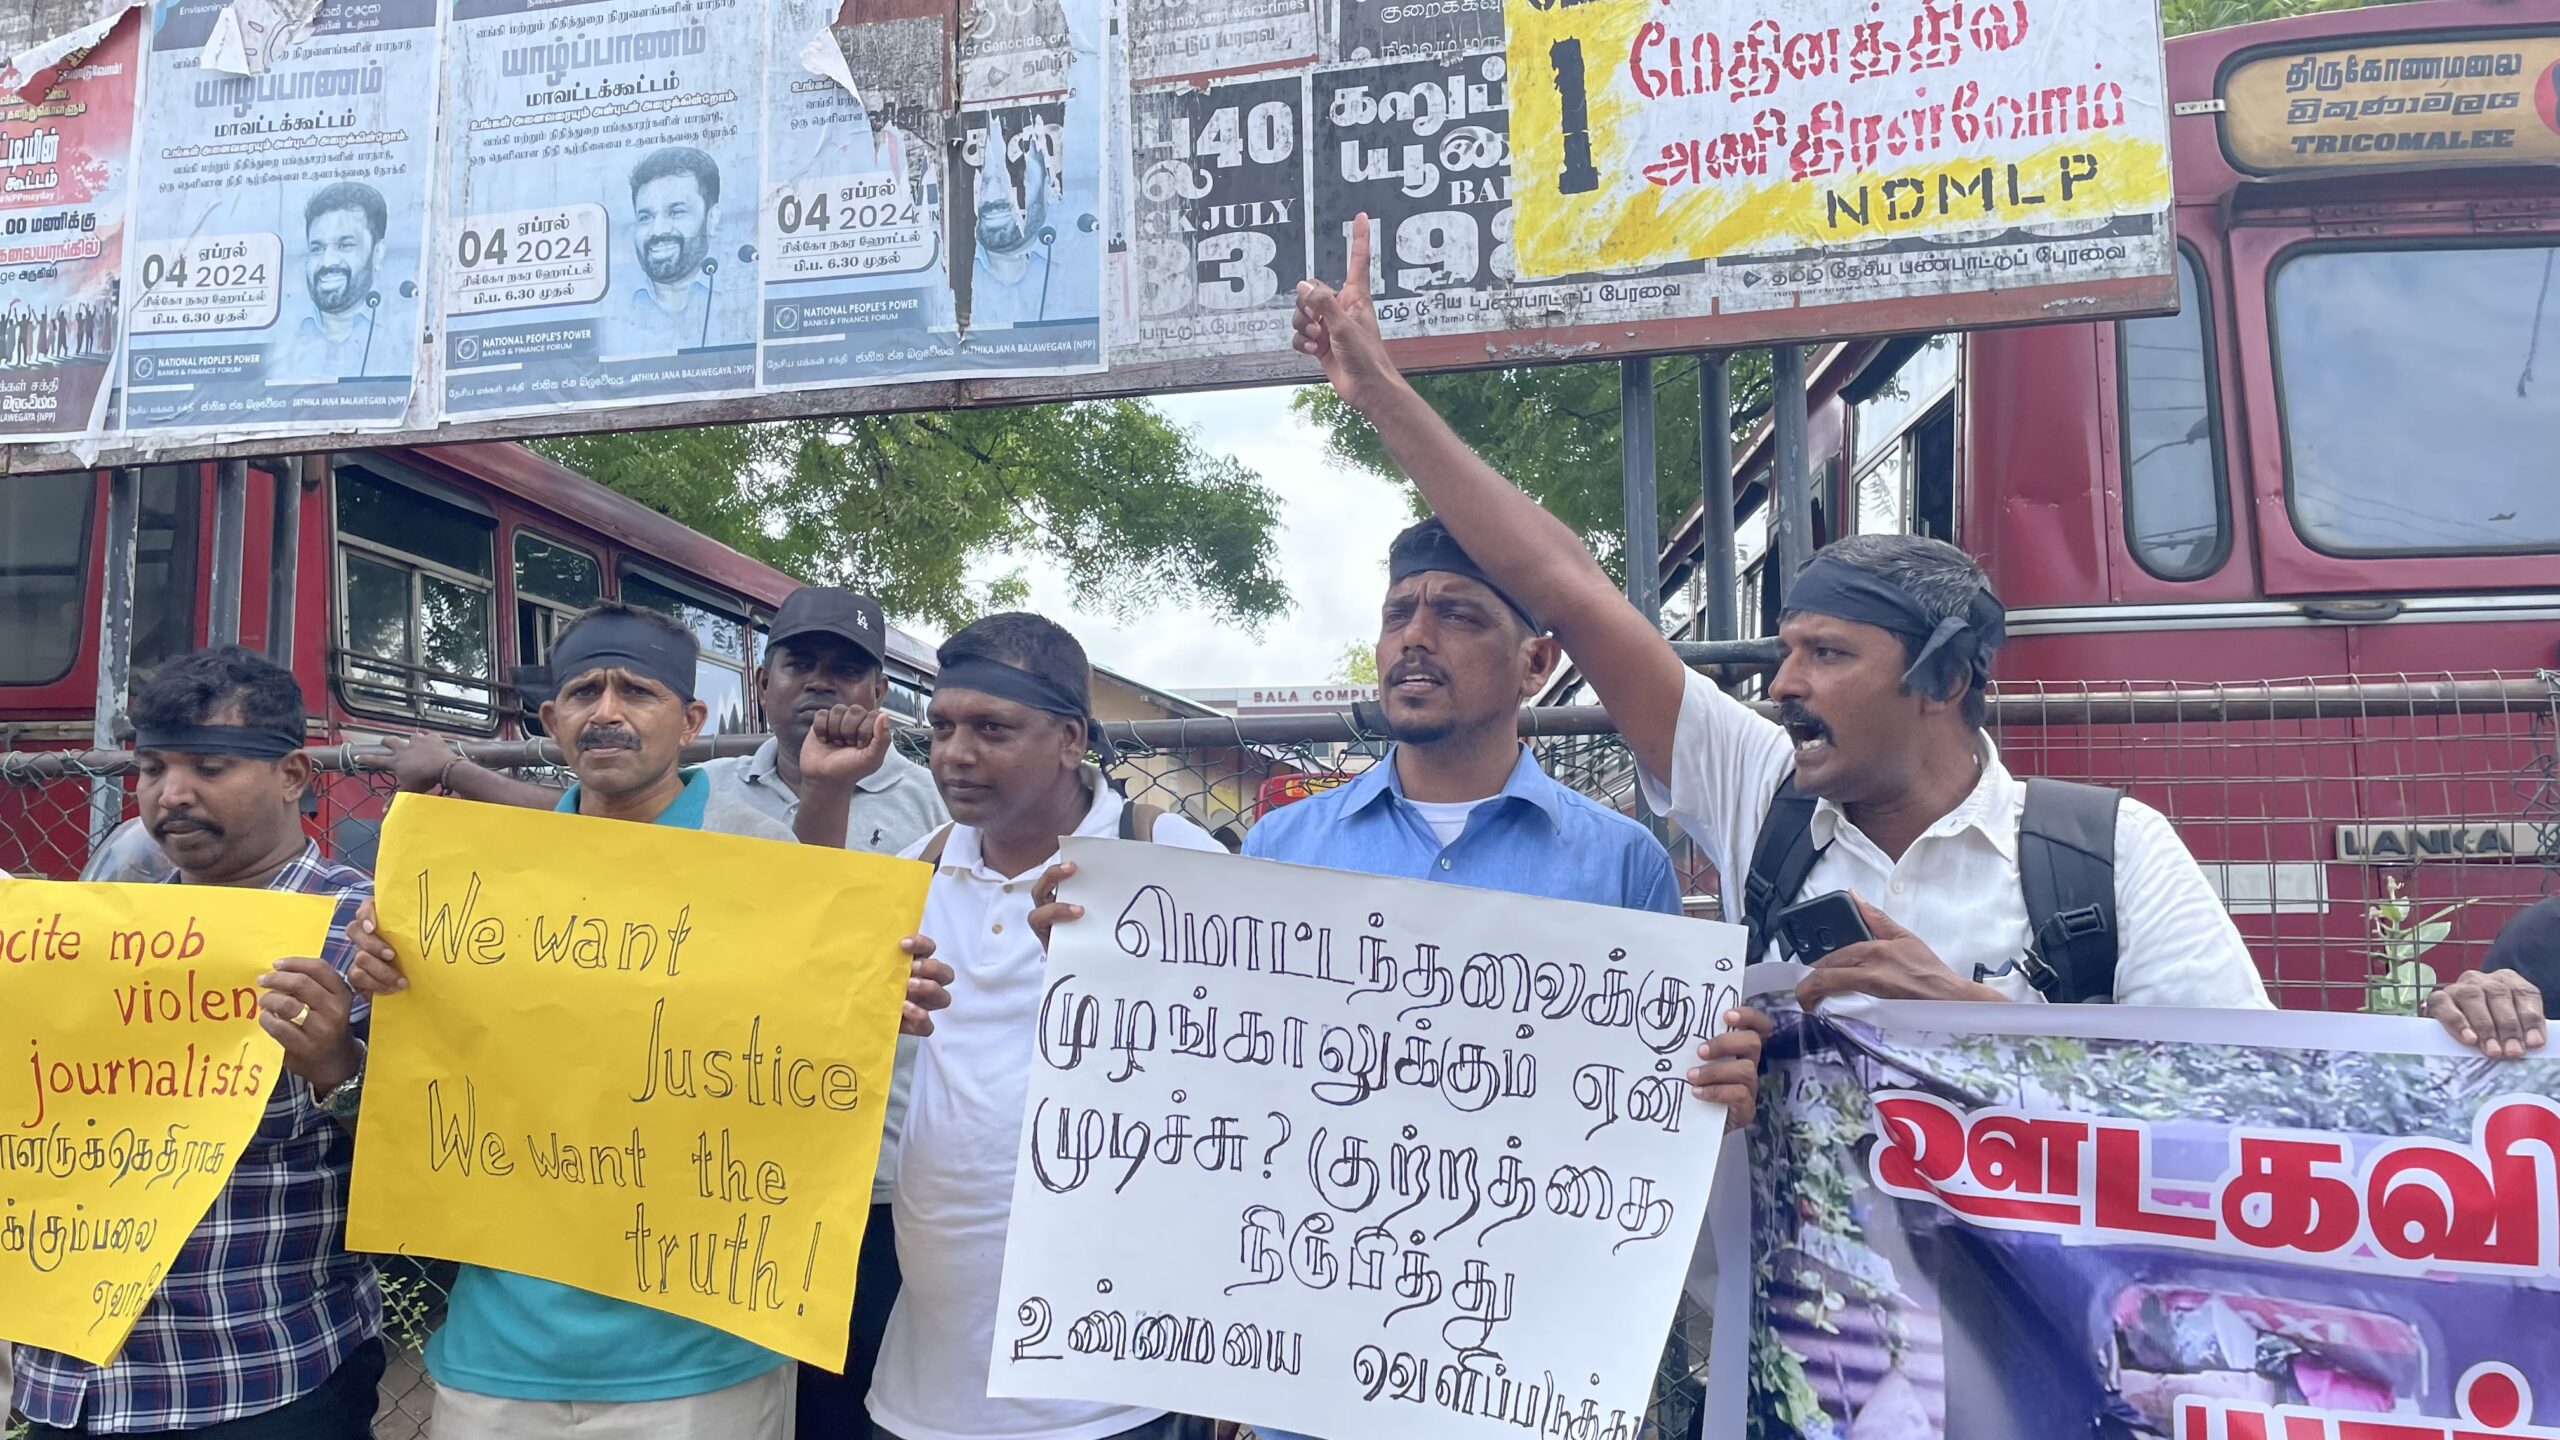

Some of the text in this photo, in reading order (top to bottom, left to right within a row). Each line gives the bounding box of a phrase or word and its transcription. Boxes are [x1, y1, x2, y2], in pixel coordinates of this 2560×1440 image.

[502, 17, 706, 86] யாழ்ப்பாணம்
[982, 34, 1046, 54] Genocide,
[2286, 53, 2522, 93] திருகோணமலை
[526, 70, 680, 107] மாவட்டக்கூட்டம்
[214, 108, 357, 138] மாவட்டக்கூட்டம்
[469, 116, 511, 131] உங்கள்
[512, 106, 590, 127] அனைவரையும்
[592, 99, 639, 118] அன்புடன்
[1196, 101, 1294, 168] 40
[2291, 129, 2516, 154] TRICOMALEE
[840, 178, 896, 202] ஏப்ரல்
[1826, 153, 2098, 228] NDMLP
[31, 211, 96, 232] மணிக்கு
[517, 213, 570, 236] ஏப்ரல்
[778, 193, 916, 234] 04 2024
[1202, 198, 1297, 231] JULY
[198, 241, 248, 261] ஏப்ரல்
[458, 228, 591, 268] 04 2024
[830, 238, 855, 251] நகர
[859, 230, 921, 248] ஹோட்டல்
[143, 254, 266, 290] 04 2024
[507, 271, 532, 284] நகர
[535, 262, 593, 280] ஹோட்டல்
[794, 251, 901, 272] பி.ப. 6.30 முதல்
[1772, 242, 2127, 287] தமிழ் தேசிய பண்பாட்டுப் பேரவை
[474, 282, 575, 305] பி.ப. 6.30 முதல்
[1599, 283, 1681, 303] பேரவை
[152, 308, 248, 325] பி.ப. 6.30 முதல்
[803, 299, 919, 318] NATIONAL PEOPLE'S POWER
[803, 312, 899, 329] BANKS FINANCE FORUM
[482, 329, 592, 348] NATIONAL PEOPLE'S POWER
[482, 342, 573, 358] BANKS FINANCE FORUM
[995, 342, 1016, 354] JANA
[1018, 340, 1072, 353] BALAWEGAYA
[1073, 340, 1096, 352] (NPP)
[157, 366, 242, 377] BANKS FINANCE FORUM
[158, 353, 260, 367] NATIONAL PEOPLE'S POWER
[31, 377, 59, 394] சக்தி
[630, 364, 755, 384] JATHIKA JANA BALAWEGAYA (NPP)
[292, 395, 408, 407] JATHIKA JANA BALAWEGAYA (NPP)
[37, 411, 56, 423] (NPP)
[856, 609, 869, 631] LA
[1253, 690, 1299, 703] BALA
[2344, 828, 2512, 856] LANKA
[418, 869, 693, 977] We want
[110, 916, 205, 971] mob
[114, 970, 259, 1027] violen
[629, 997, 859, 1112] Justice
[21, 1040, 263, 1129] journalists
[1573, 1060, 1690, 1141] ஏன்
[428, 1075, 515, 1178] We
[692, 1128, 789, 1205] the
[1031, 1089, 1292, 1194] முடிச்சு?
[625, 1202, 822, 1316] truth!
